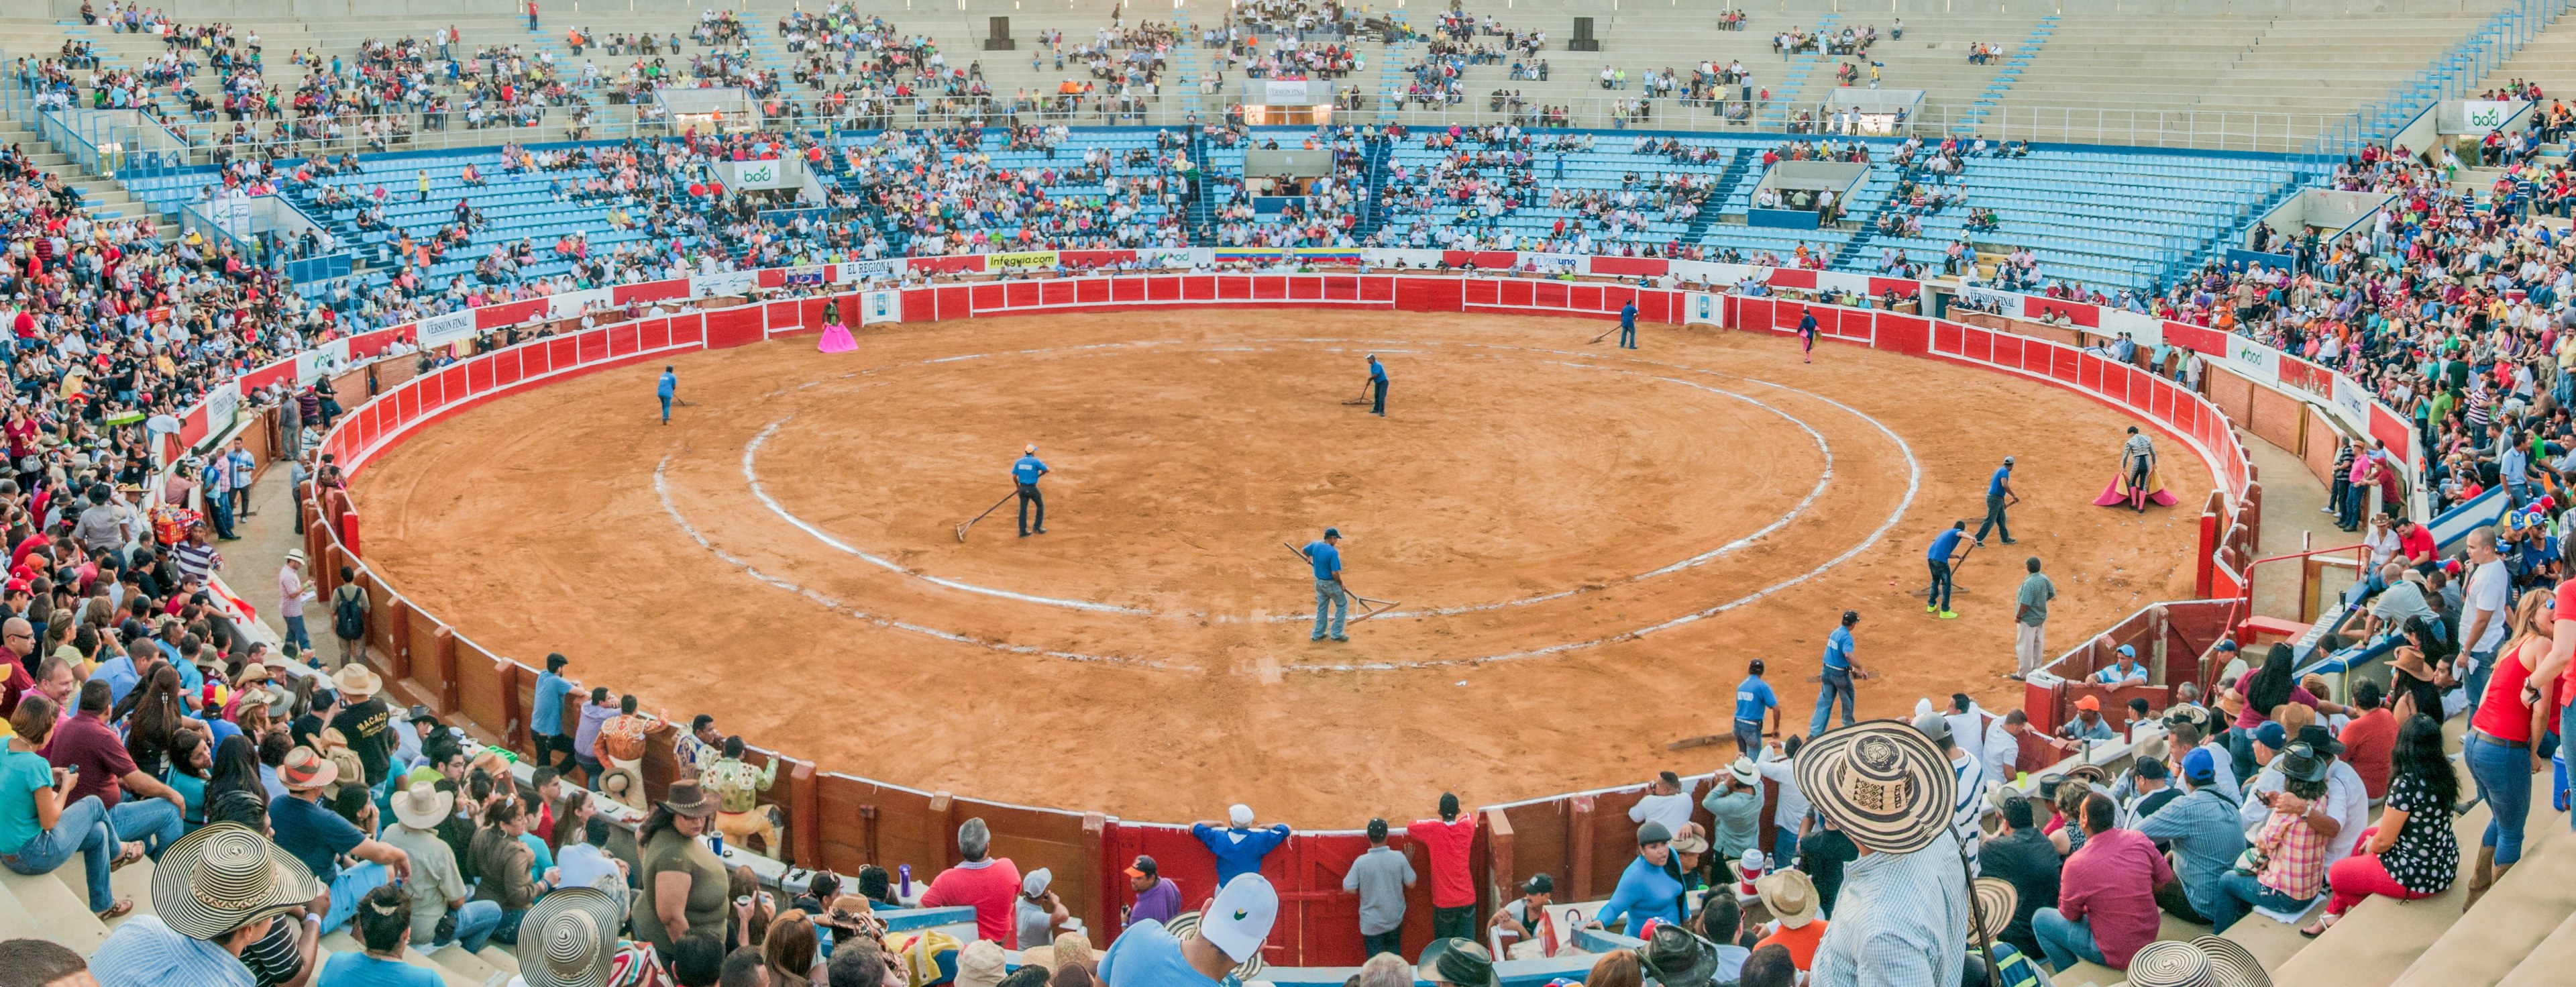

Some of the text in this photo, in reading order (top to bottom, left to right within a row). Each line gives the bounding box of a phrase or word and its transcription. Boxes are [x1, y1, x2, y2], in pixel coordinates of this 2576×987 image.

[2473, 111, 2499, 126] bod
[744, 168, 771, 183] bod
[848, 264, 857, 274] EL
[1998, 296, 2015, 307] FINAL
[452, 316, 468, 329] FINAL
[2247, 346, 2262, 366] bod
